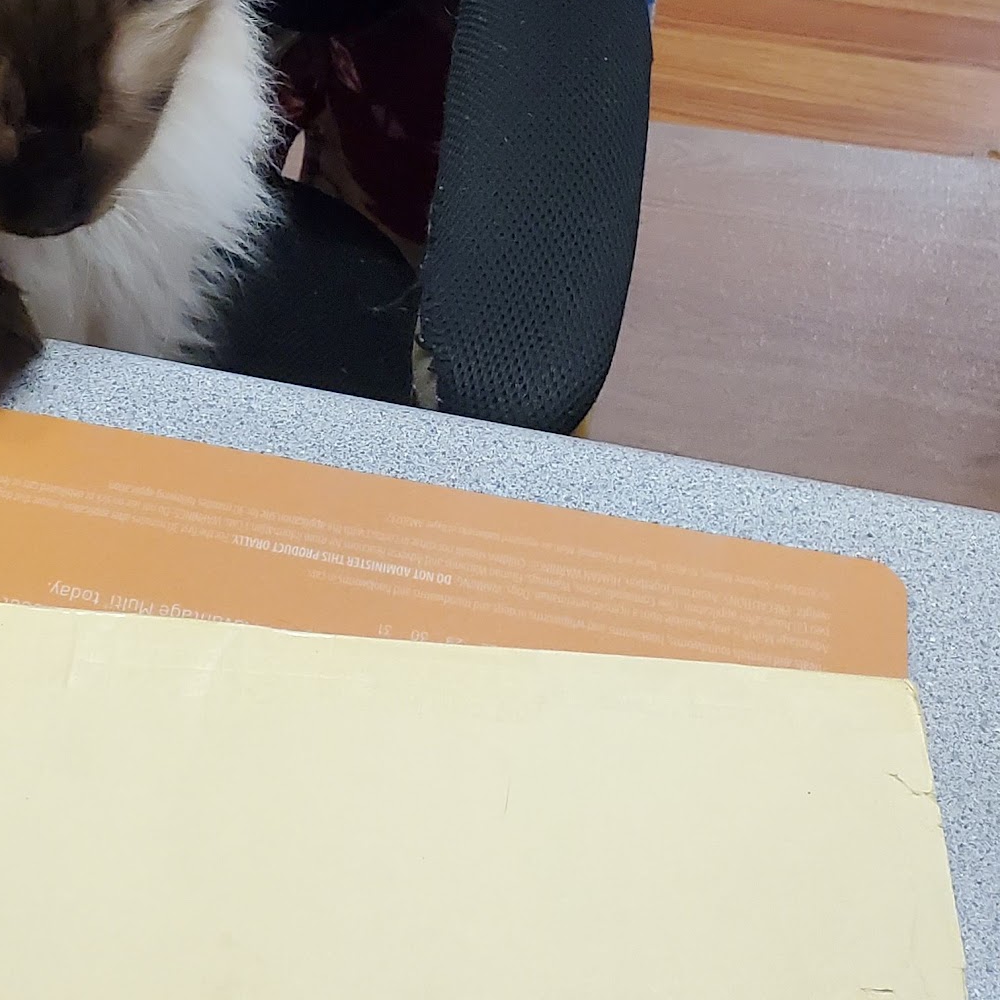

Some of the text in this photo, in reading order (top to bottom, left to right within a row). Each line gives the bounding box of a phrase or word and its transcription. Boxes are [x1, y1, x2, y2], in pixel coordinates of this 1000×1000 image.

[231, 534, 271, 552] ORALLY.
[272, 541, 320, 561] PRODUCT
[321, 550, 346, 566] THIS
[347, 555, 412, 577] ADMINISTER
[413, 567, 436, 583] NOT
[437, 572, 453, 586] DO
[47, 579, 100, 607] today.
[110, 594, 154, 616] Multi
[379, 623, 393, 638] 31
